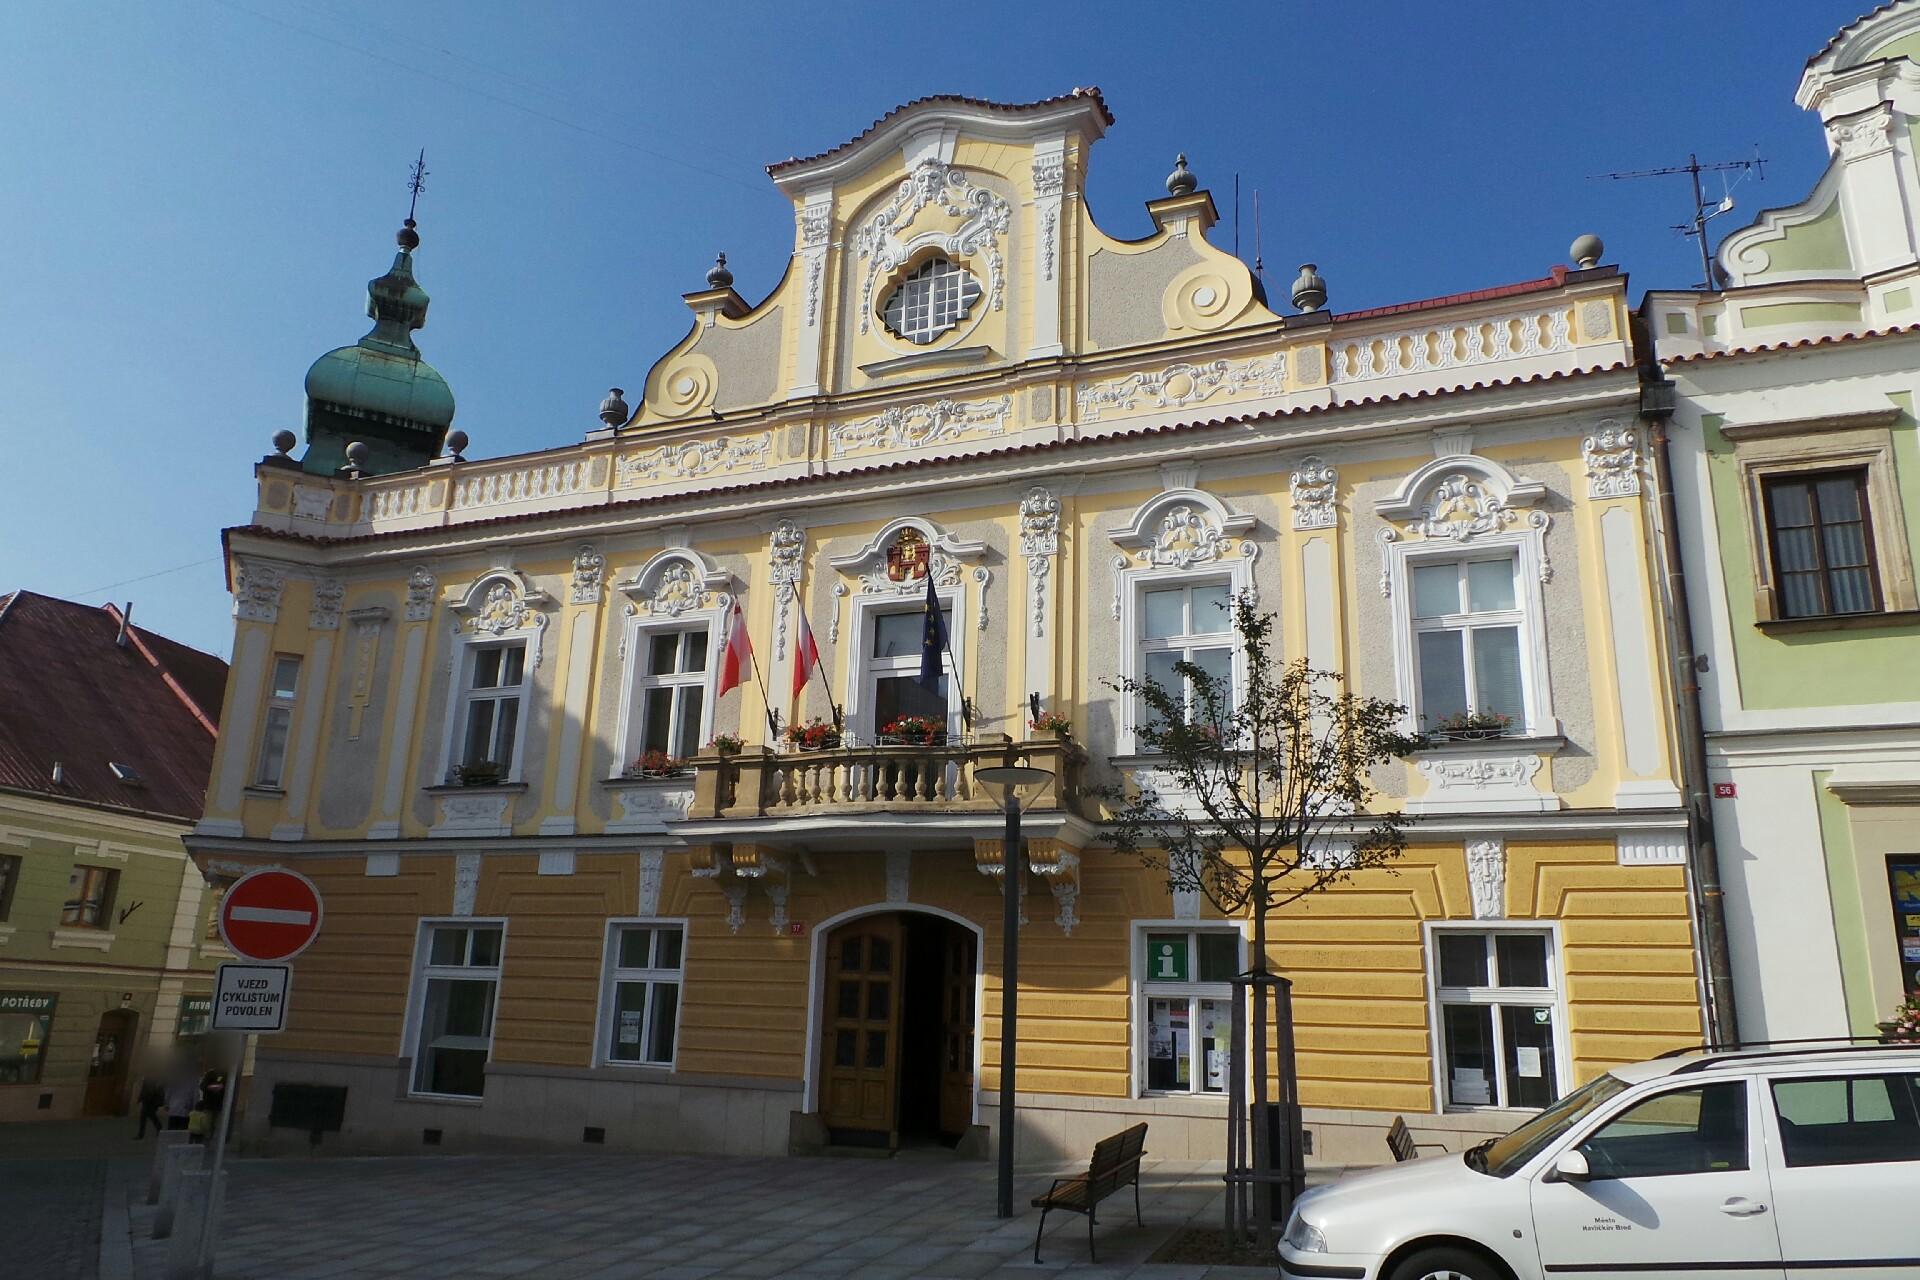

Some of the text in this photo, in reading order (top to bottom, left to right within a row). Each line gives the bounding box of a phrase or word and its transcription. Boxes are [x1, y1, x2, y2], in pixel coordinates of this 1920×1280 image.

[1719, 786, 1732, 795] 56
[237, 980, 268, 989] VJEZD
[225, 1006, 272, 1016] POVOLEN
